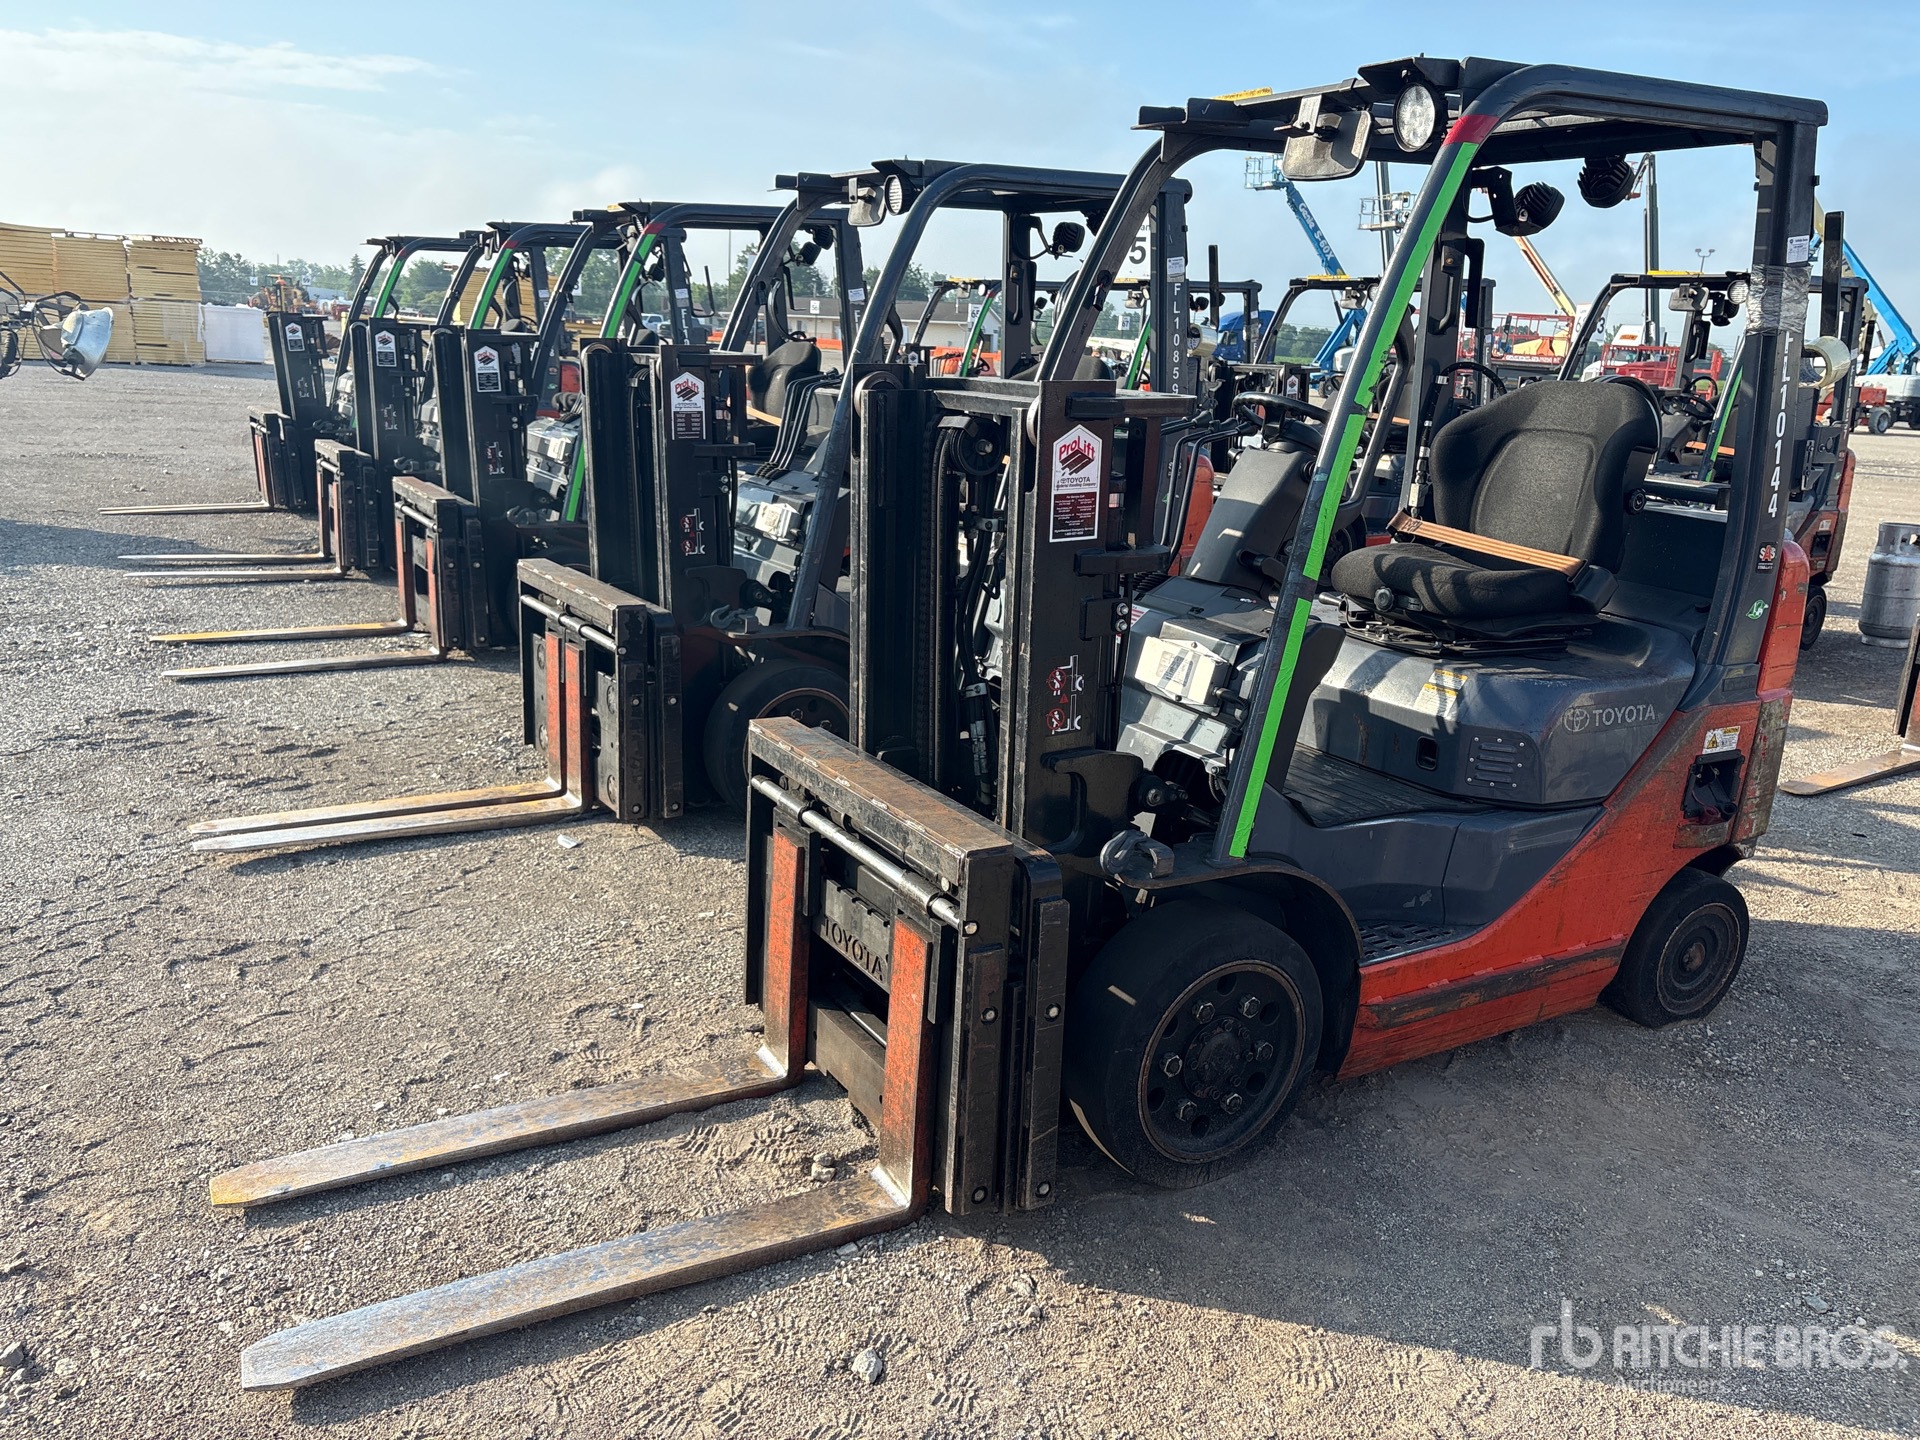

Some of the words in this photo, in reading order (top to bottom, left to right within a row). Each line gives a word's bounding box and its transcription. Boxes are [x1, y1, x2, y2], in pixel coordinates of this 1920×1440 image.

[1298, 202, 1315, 230] Genie
[1313, 230, 1335, 261] S-60X
[674, 377, 700, 393] ProLift
[1766, 330, 1795, 519] FL10144
[1058, 435, 1096, 462] ProLift
[1592, 704, 1656, 727] TOYOTA
[823, 914, 884, 982] TOYOTA
